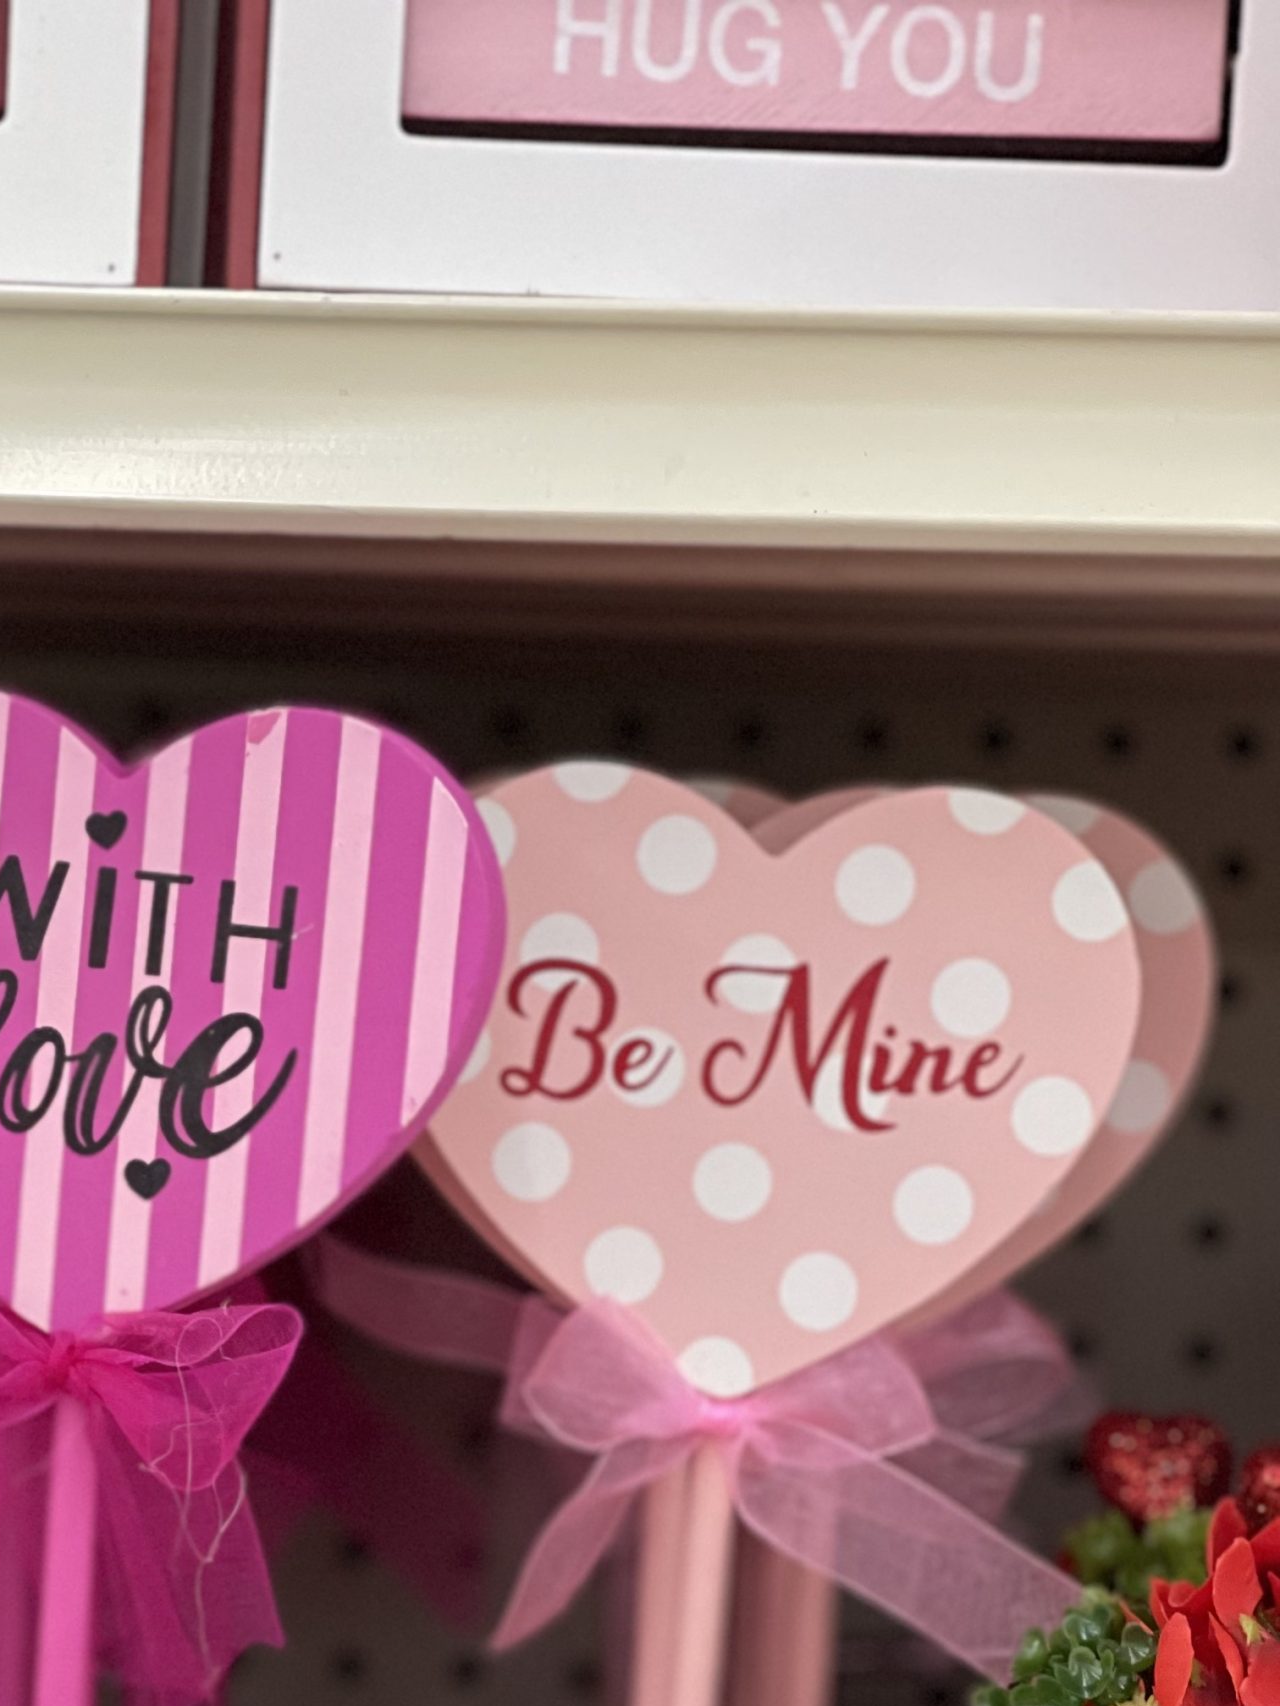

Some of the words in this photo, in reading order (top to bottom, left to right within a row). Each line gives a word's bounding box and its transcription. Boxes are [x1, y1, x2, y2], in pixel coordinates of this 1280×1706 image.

[553, 0, 783, 87] HUG
[824, 2, 1044, 101] YOU
[499, 957, 674, 1103] Be
[700, 956, 1024, 1133] Mine
